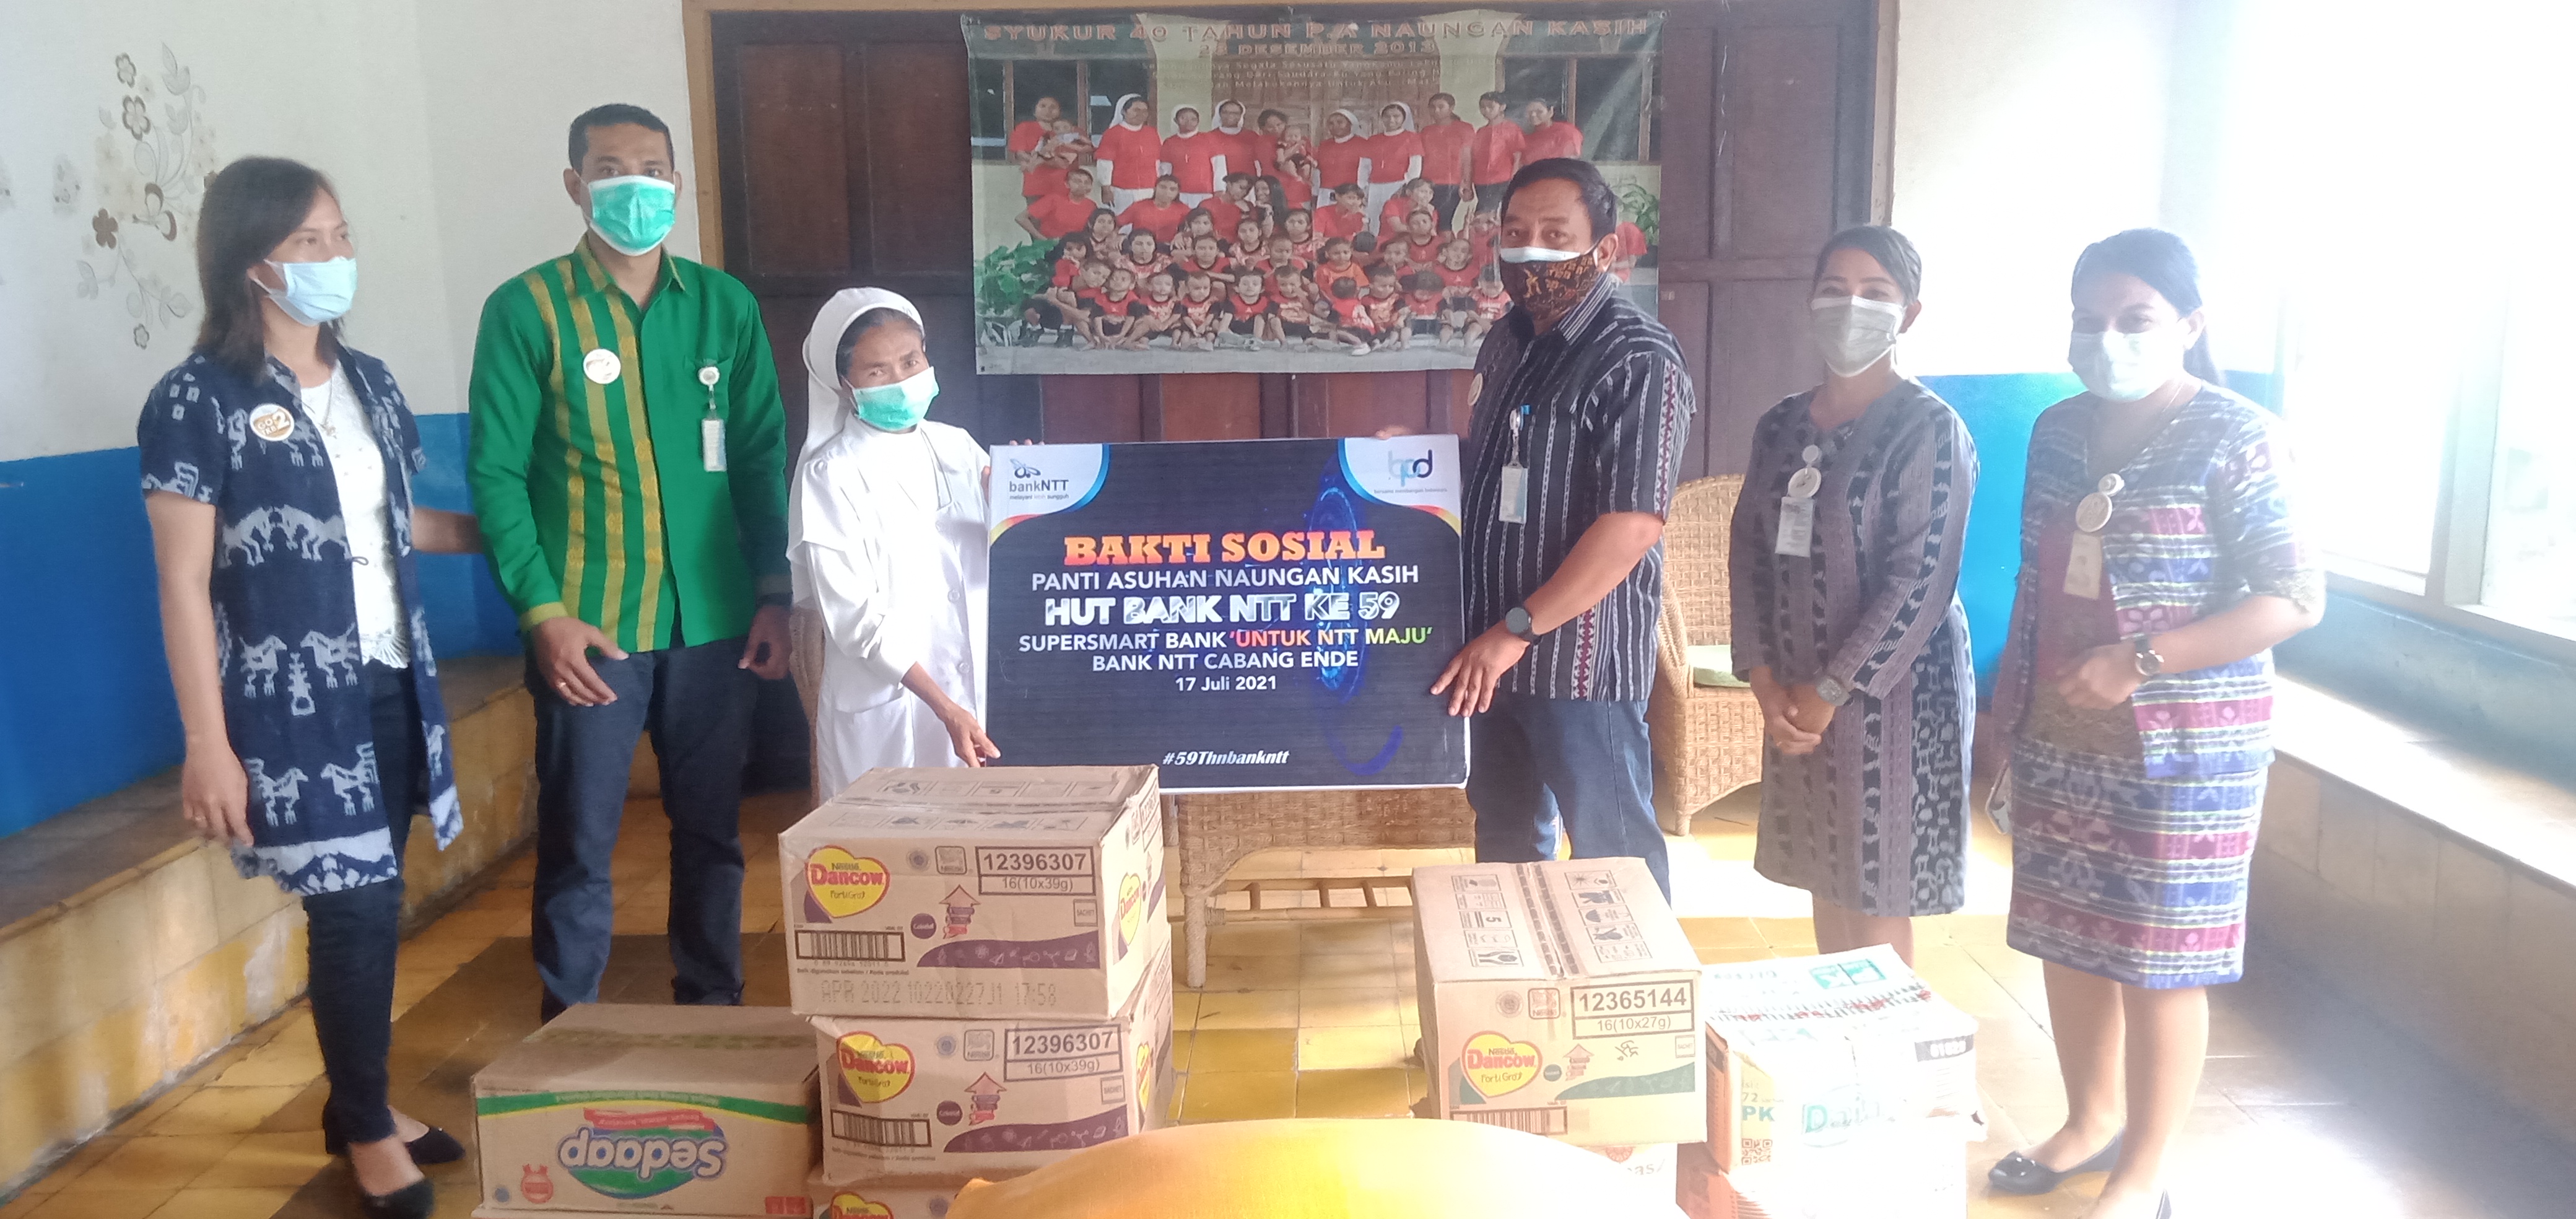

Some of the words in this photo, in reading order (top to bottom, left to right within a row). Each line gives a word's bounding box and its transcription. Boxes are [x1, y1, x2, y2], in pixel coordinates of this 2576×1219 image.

[984, 24, 1116, 41] SYUKUR
[1130, 25, 1168, 42] 40
[1182, 23, 1292, 42] TAHUN
[1370, 19, 1534, 39] NAUNGAN
[1548, 19, 1648, 36] KASIH
[1238, 42, 1364, 56] DESEMBER
[1373, 41, 1435, 55] 2013
[1009, 479, 1069, 492] bankNTT
[1063, 533, 1211, 566] BAKTI
[1221, 529, 1386, 562] SOSIAL
[1032, 571, 1099, 591] PANTI
[1107, 569, 1208, 590] ASUHAN
[1214, 566, 1340, 588] NAUNGAN
[1347, 564, 1419, 584] KASIH
[1045, 596, 1116, 627] HUT
[1123, 595, 1223, 625] BANK
[1229, 593, 1297, 623] NTT
[1304, 592, 1351, 621] KE
[1358, 590, 1401, 621] 59
[1019, 632, 1160, 652] SUPERSMART
[1165, 631, 1227, 649] BANK
[1318, 628, 1359, 646] NTT
[1092, 654, 1152, 672] BANK
[1158, 653, 1199, 671] NTT
[1204, 652, 1295, 670] CABANG
[1300, 650, 1359, 668] ENDE
[1175, 677, 1196, 692] 17
[1201, 676, 1230, 692] Juli
[1235, 675, 1277, 691] 2021
[1162, 749, 1290, 767] #59Thnbankntt
[983, 852, 1087, 871] 12396307
[810, 863, 884, 885] Dancow
[1002, 876, 1073, 892] 16(10x39g)
[822, 979, 854, 1003] APR
[861, 980, 901, 1003] 2022
[1579, 987, 1687, 1012] 12365144
[1597, 1015, 1671, 1033] 16(10x27g)
[1012, 1031, 1113, 1055] 12396307
[841, 1049, 909, 1074] Dancow
[1027, 1059, 1100, 1076] 16(10x39g)
[1467, 1048, 1536, 1070] Dancow
[1742, 1105, 1775, 1122] PK
[559, 1126, 727, 1178] Sedaap
